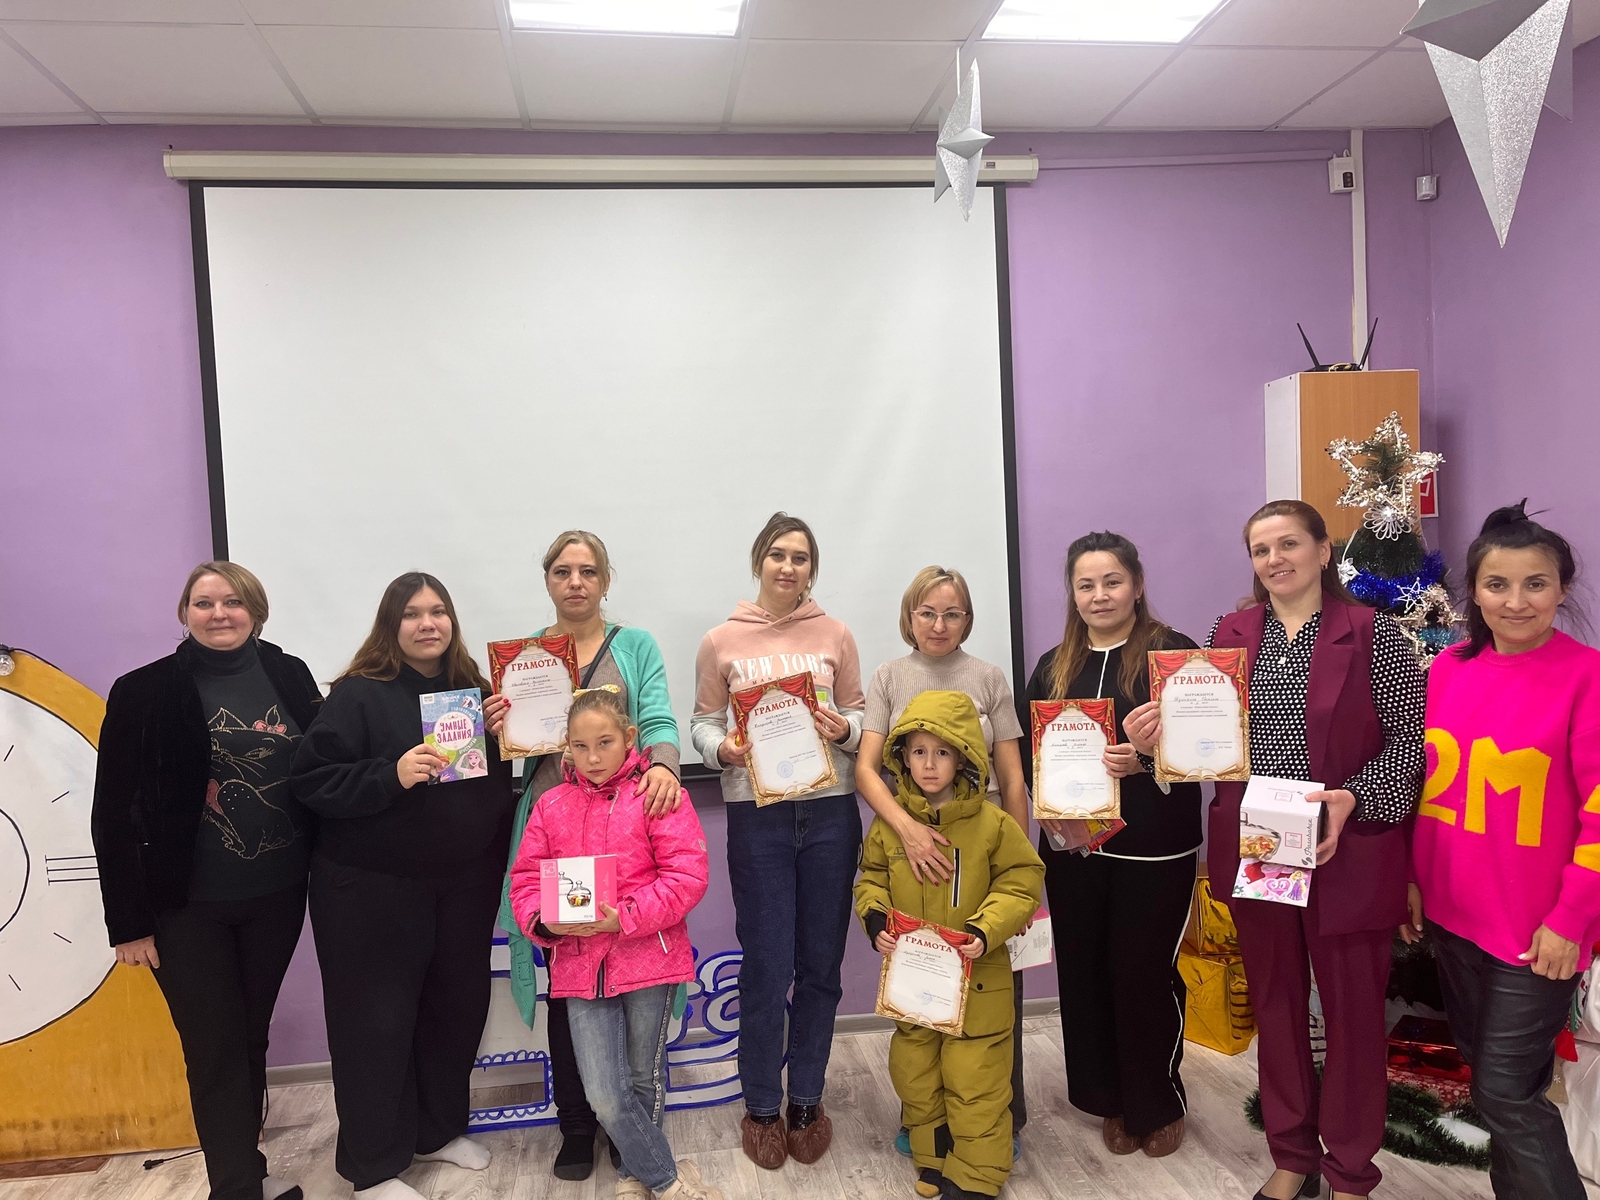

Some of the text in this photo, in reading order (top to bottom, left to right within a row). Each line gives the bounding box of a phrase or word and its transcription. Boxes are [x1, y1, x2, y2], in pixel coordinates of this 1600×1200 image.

[511, 658, 558, 672] ГРАМОТА
[732, 653, 830, 684] NEW YORK
[1173, 675, 1226, 685] ГРАМОТА
[754, 697, 799, 717] ГРАМОТА
[440, 718, 467, 732] УМНЫЕ
[1051, 723, 1097, 731] ГРАМОТА
[437, 729, 472, 743] ЗАДАНИЯ
[905, 935, 953, 953] ГРАМОТА
